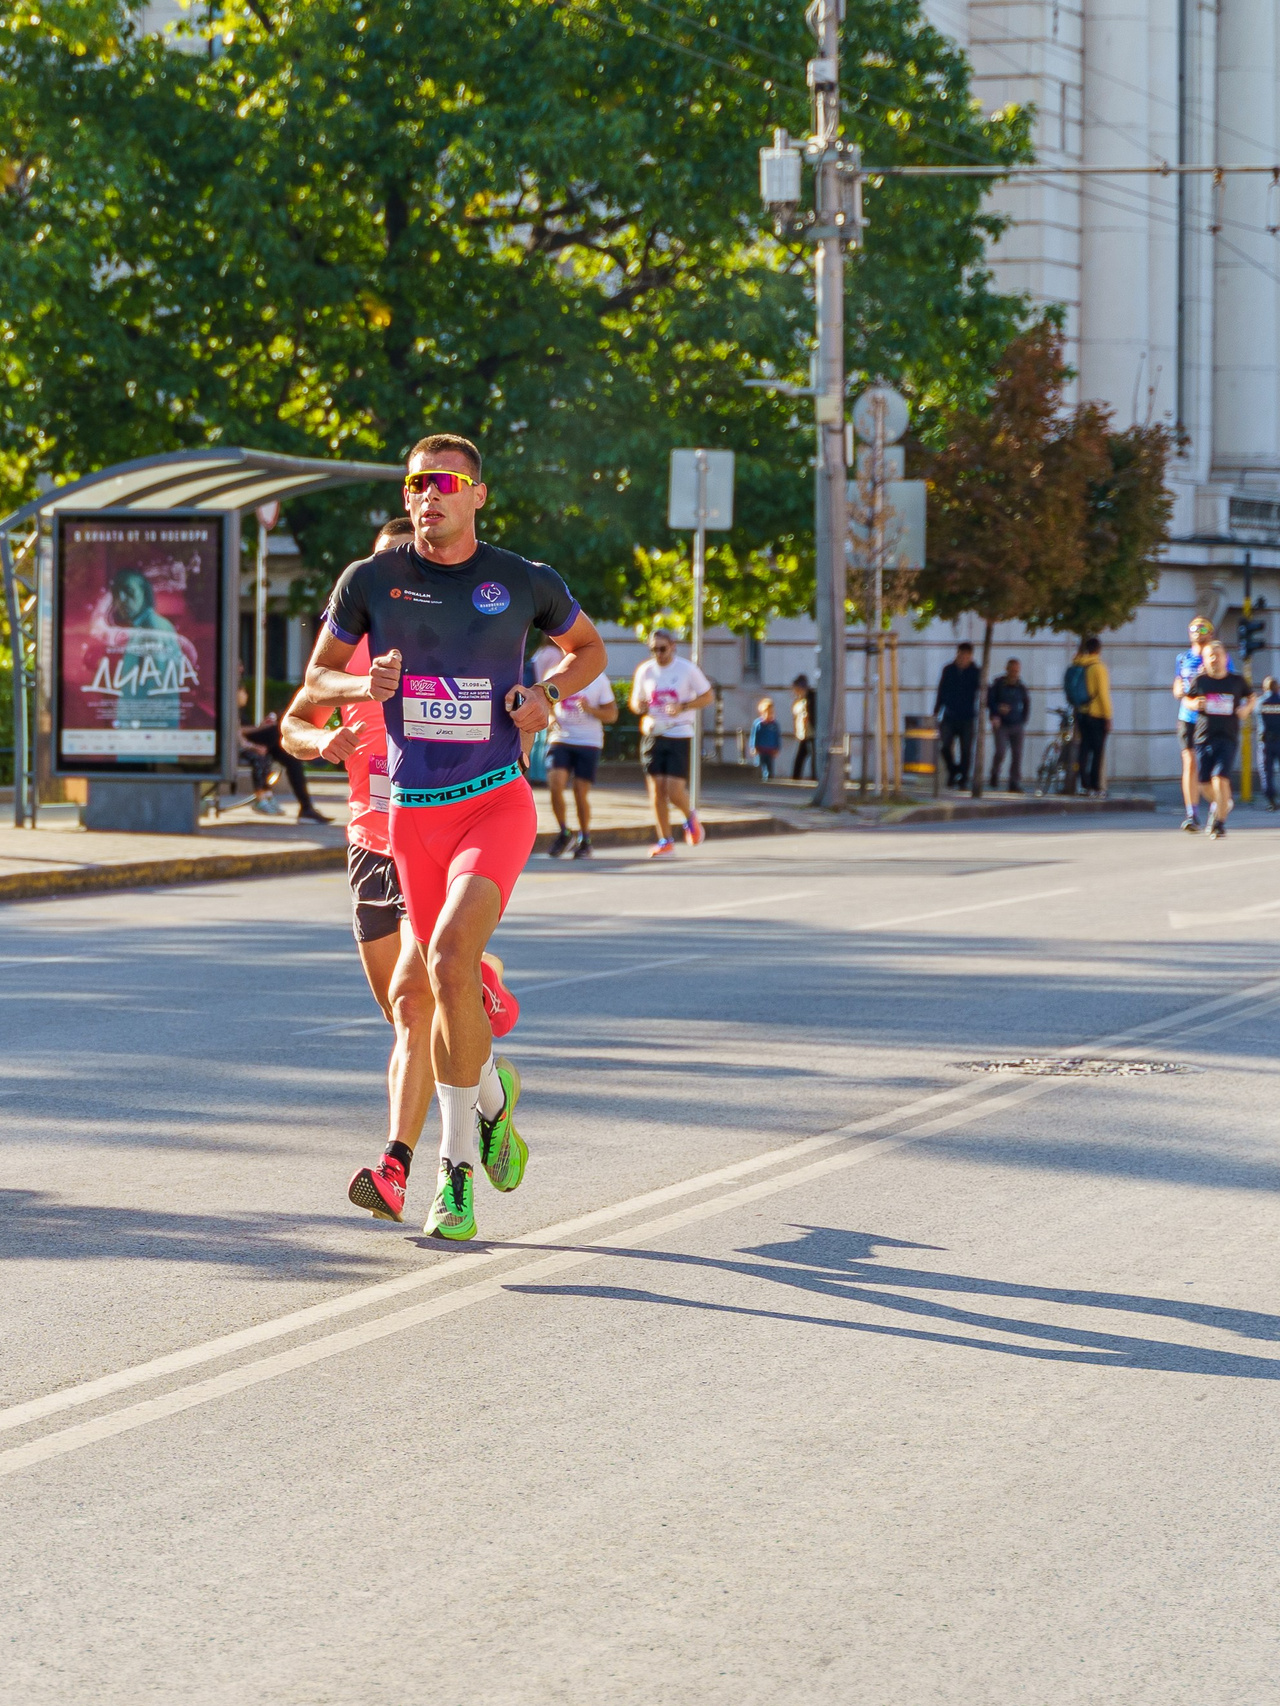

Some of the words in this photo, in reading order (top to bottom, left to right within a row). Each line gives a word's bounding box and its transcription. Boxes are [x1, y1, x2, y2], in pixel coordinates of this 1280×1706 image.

[127, 530, 140, 542] ОТ
[80, 655, 200, 696] ДИАДА
[420, 701, 472, 720] 1699
[393, 770, 506, 803] ARMOUR
